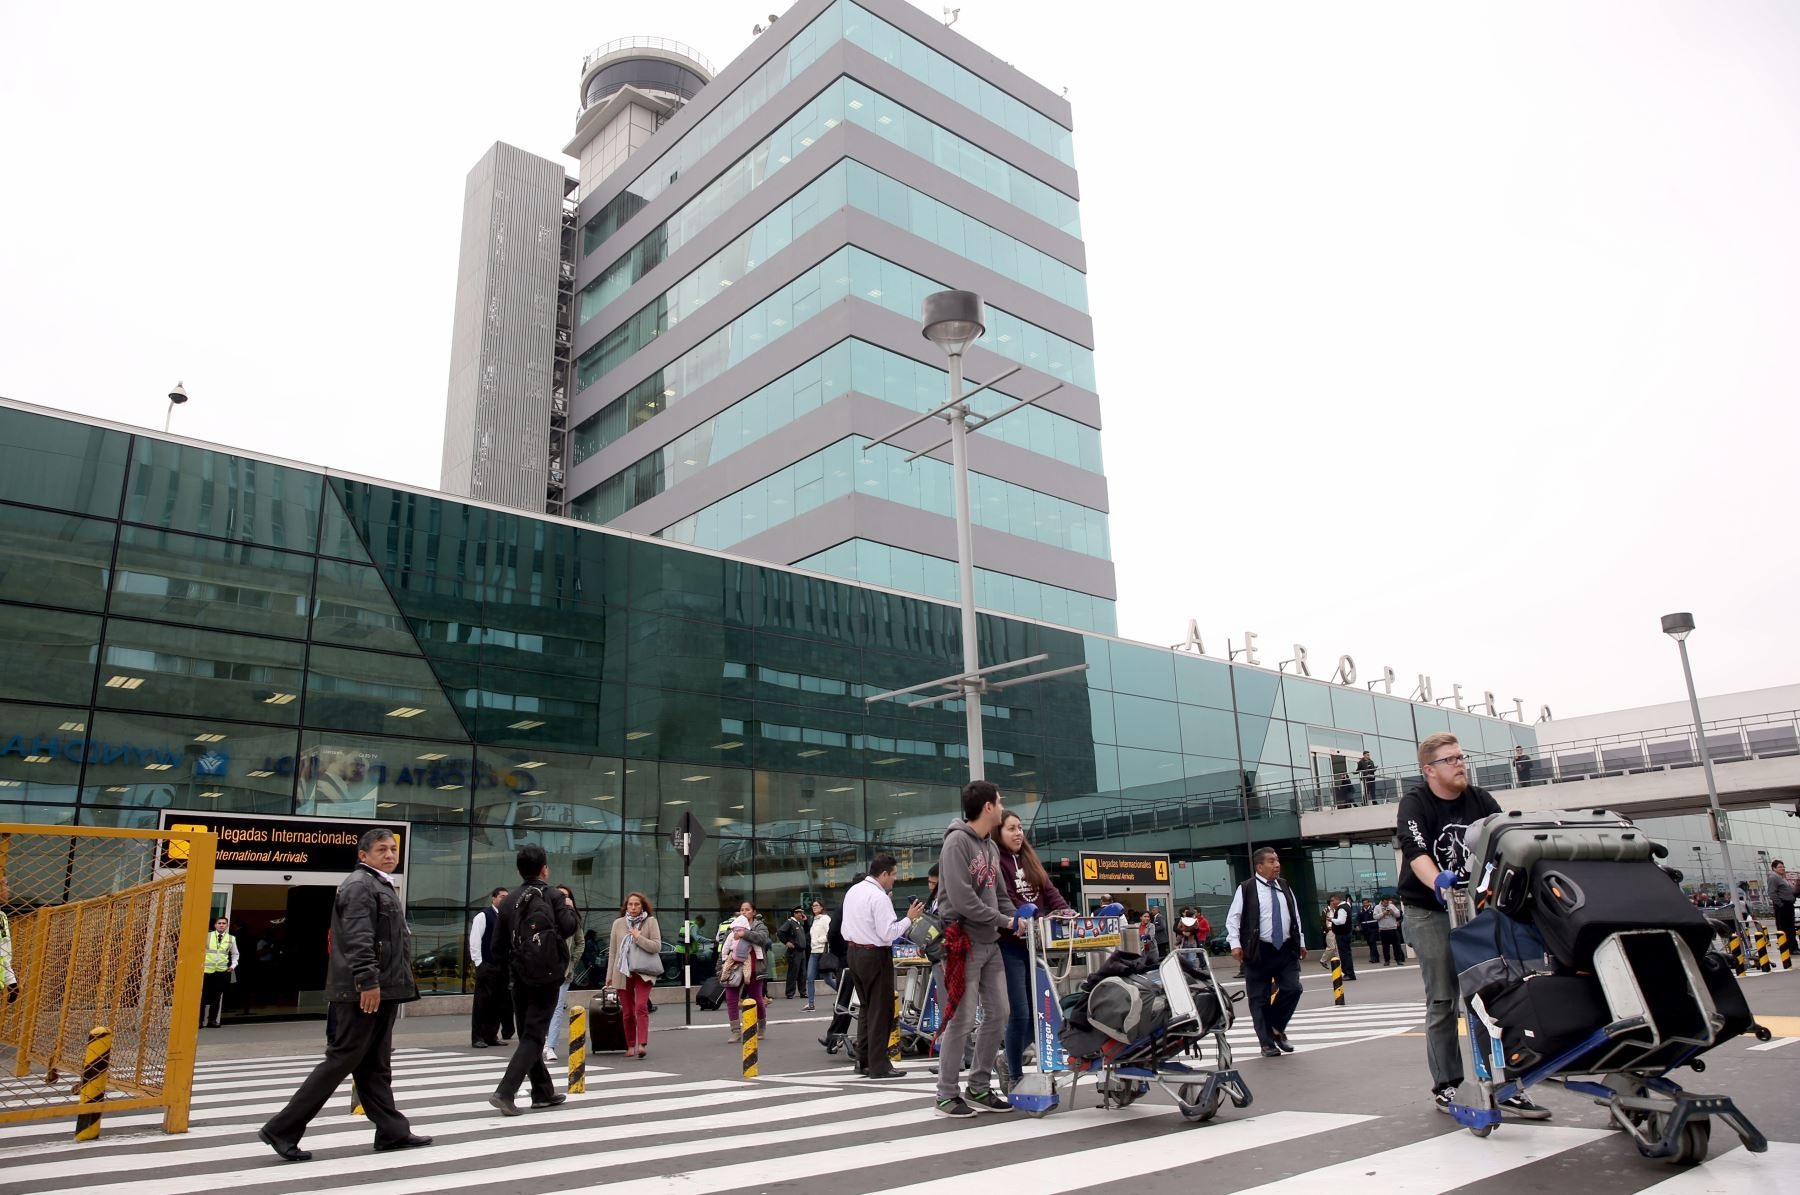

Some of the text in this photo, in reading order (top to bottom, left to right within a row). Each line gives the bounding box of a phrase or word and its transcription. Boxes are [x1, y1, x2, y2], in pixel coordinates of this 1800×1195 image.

[1185, 619, 1552, 722] AEROPUERTO
[214, 826, 358, 845] Llegadas Internacionales
[214, 848, 308, 863] nternational Arrivals
[1099, 859, 1151, 869] Llegadas Internacionales
[1159, 863, 1163, 878] 4
